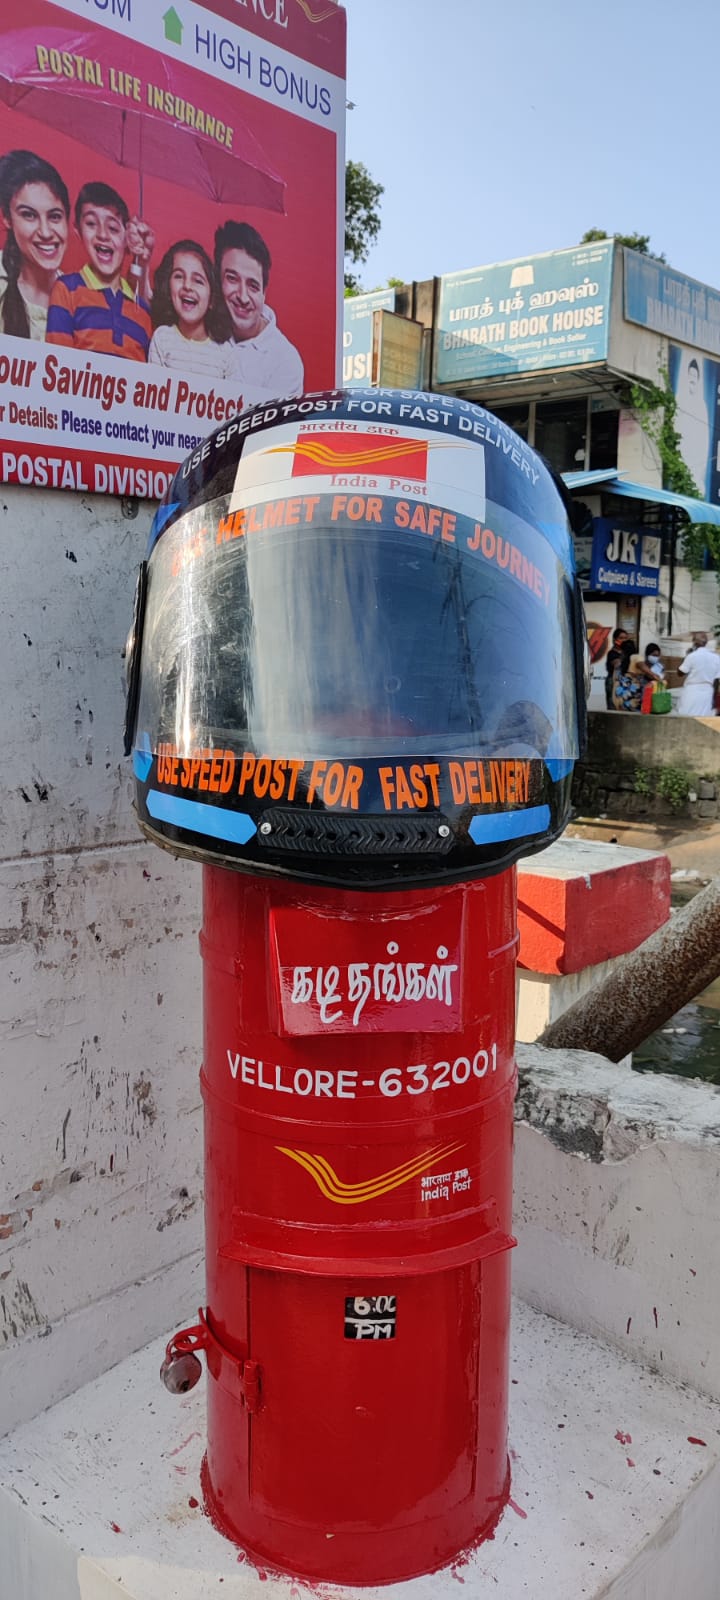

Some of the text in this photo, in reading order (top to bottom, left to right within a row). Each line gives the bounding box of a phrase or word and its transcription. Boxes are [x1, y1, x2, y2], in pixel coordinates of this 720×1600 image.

[194, 23, 332, 116] HIGH BONUS
[35, 44, 234, 150] POSTAL LIFE INSURANCE
[443, 305, 605, 350] BHARATH BOOK HOUSE
[449, 296, 494, 322] பாரத்
[498, 290, 525, 315] புக்
[42, 354, 128, 411] Savings
[133, 377, 172, 412] and
[174, 380, 244, 421] Protect
[348, 388, 393, 397] FOR
[400, 390, 454, 407] SAFE
[8, 401, 58, 430] Details:
[61, 409, 102, 436] Please
[105, 420, 149, 444] contact
[151, 429, 175, 450] your
[182, 400, 540, 485] USE SPEED POST FOR FAST DELIVERY
[299, 421, 400, 435] भारतीय डाक
[2, 452, 89, 491] POSTAL
[329, 474, 428, 496] India Post
[215, 497, 320, 545] HELMET
[331, 494, 383, 524] FOR
[394, 501, 457, 543] SAFE
[466, 522, 550, 608] JOURNEY
[606, 529, 639, 565] JK
[156, 742, 531, 811] USE SPEED POST FOR FAST DELIVERY
[226, 1043, 497, 1100] VELLORE-632001
[421, 1175, 473, 1202] India Post
[354, 1322, 392, 1340] PM
